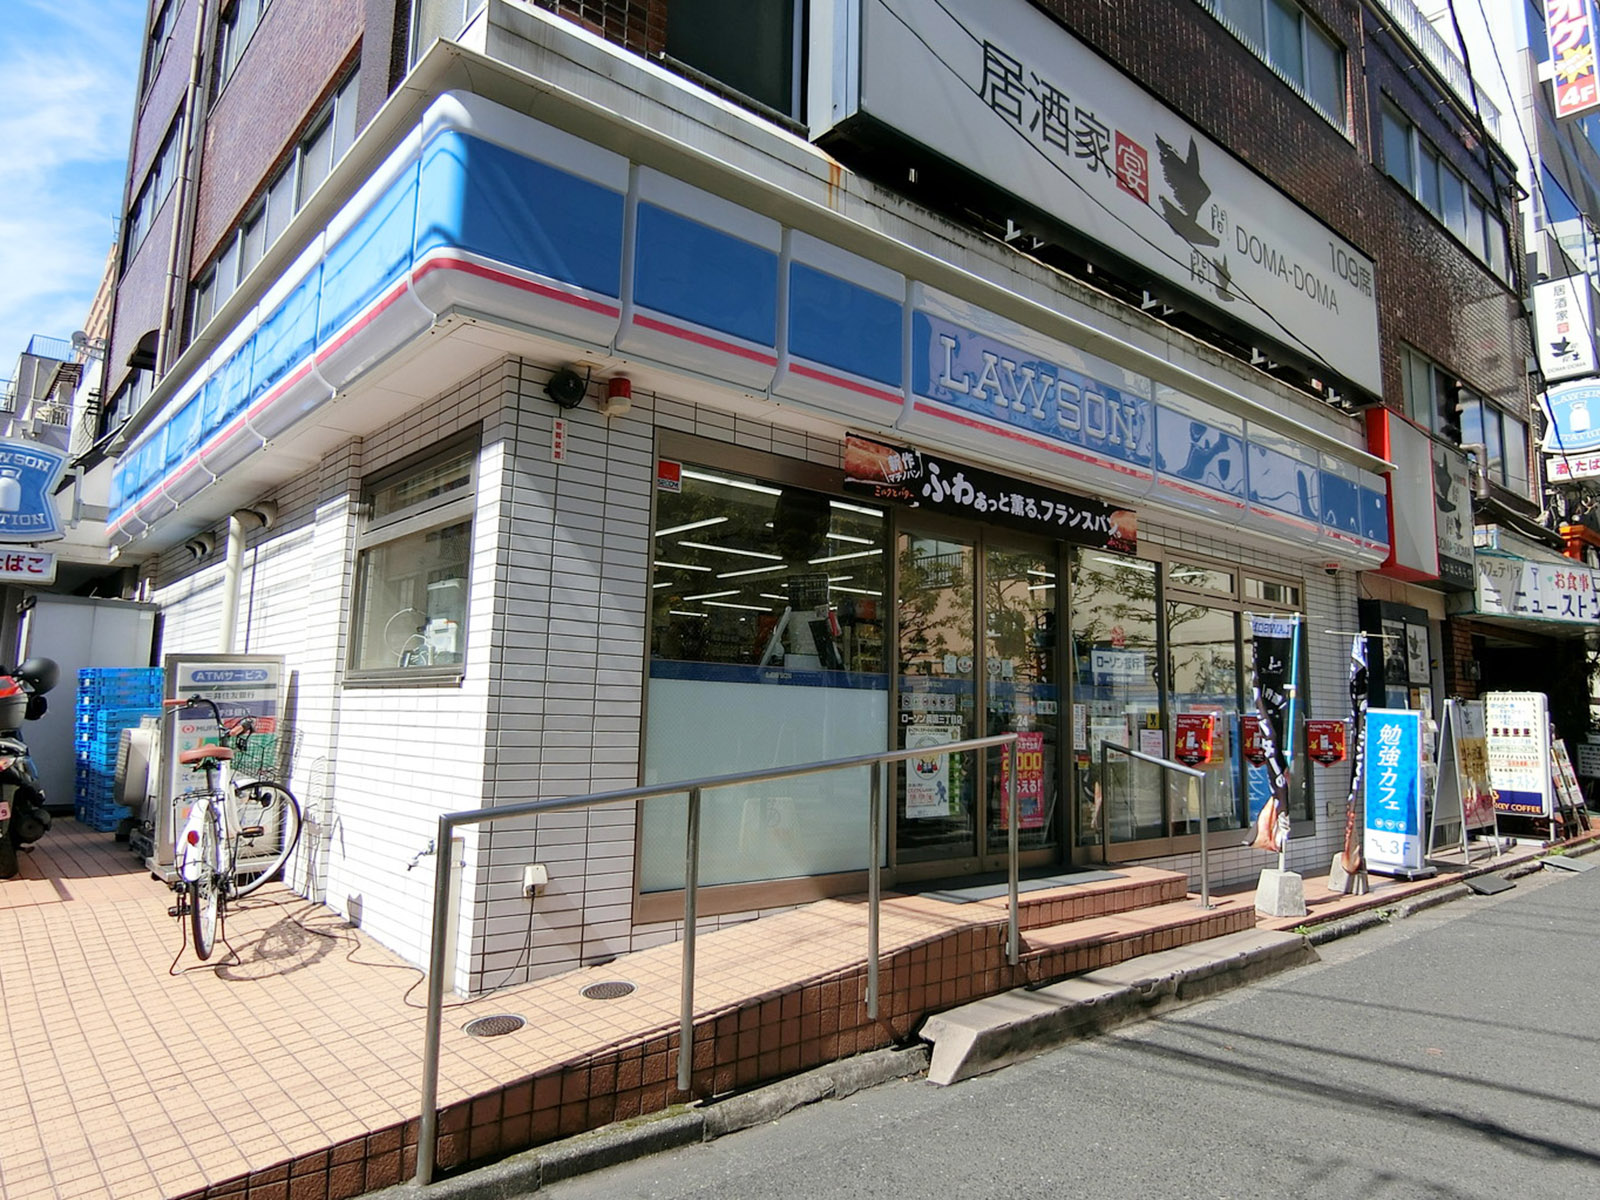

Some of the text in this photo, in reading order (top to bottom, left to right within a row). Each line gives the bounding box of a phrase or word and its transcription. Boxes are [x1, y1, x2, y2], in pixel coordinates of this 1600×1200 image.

[1560, 84, 1595, 107] 4F
[980, 39, 1147, 199] 居酒家 宴
[1236, 225, 1339, 315] DOMA-DOMA
[1328, 241, 1372, 297] 109席
[1553, 284, 1569, 321] 居酒家
[940, 334, 1137, 450] LAWSON
[0, 553, 44, 574] ばこ
[1479, 561, 1520, 581] カフェテリア
[1555, 570, 1589, 593] お食事
[195, 671, 265, 681] ATMサービス
[1377, 723, 1403, 811] 勉強カフェ
[1511, 803, 1541, 814] COFFEE
[1390, 840, 1411, 856] 3F
